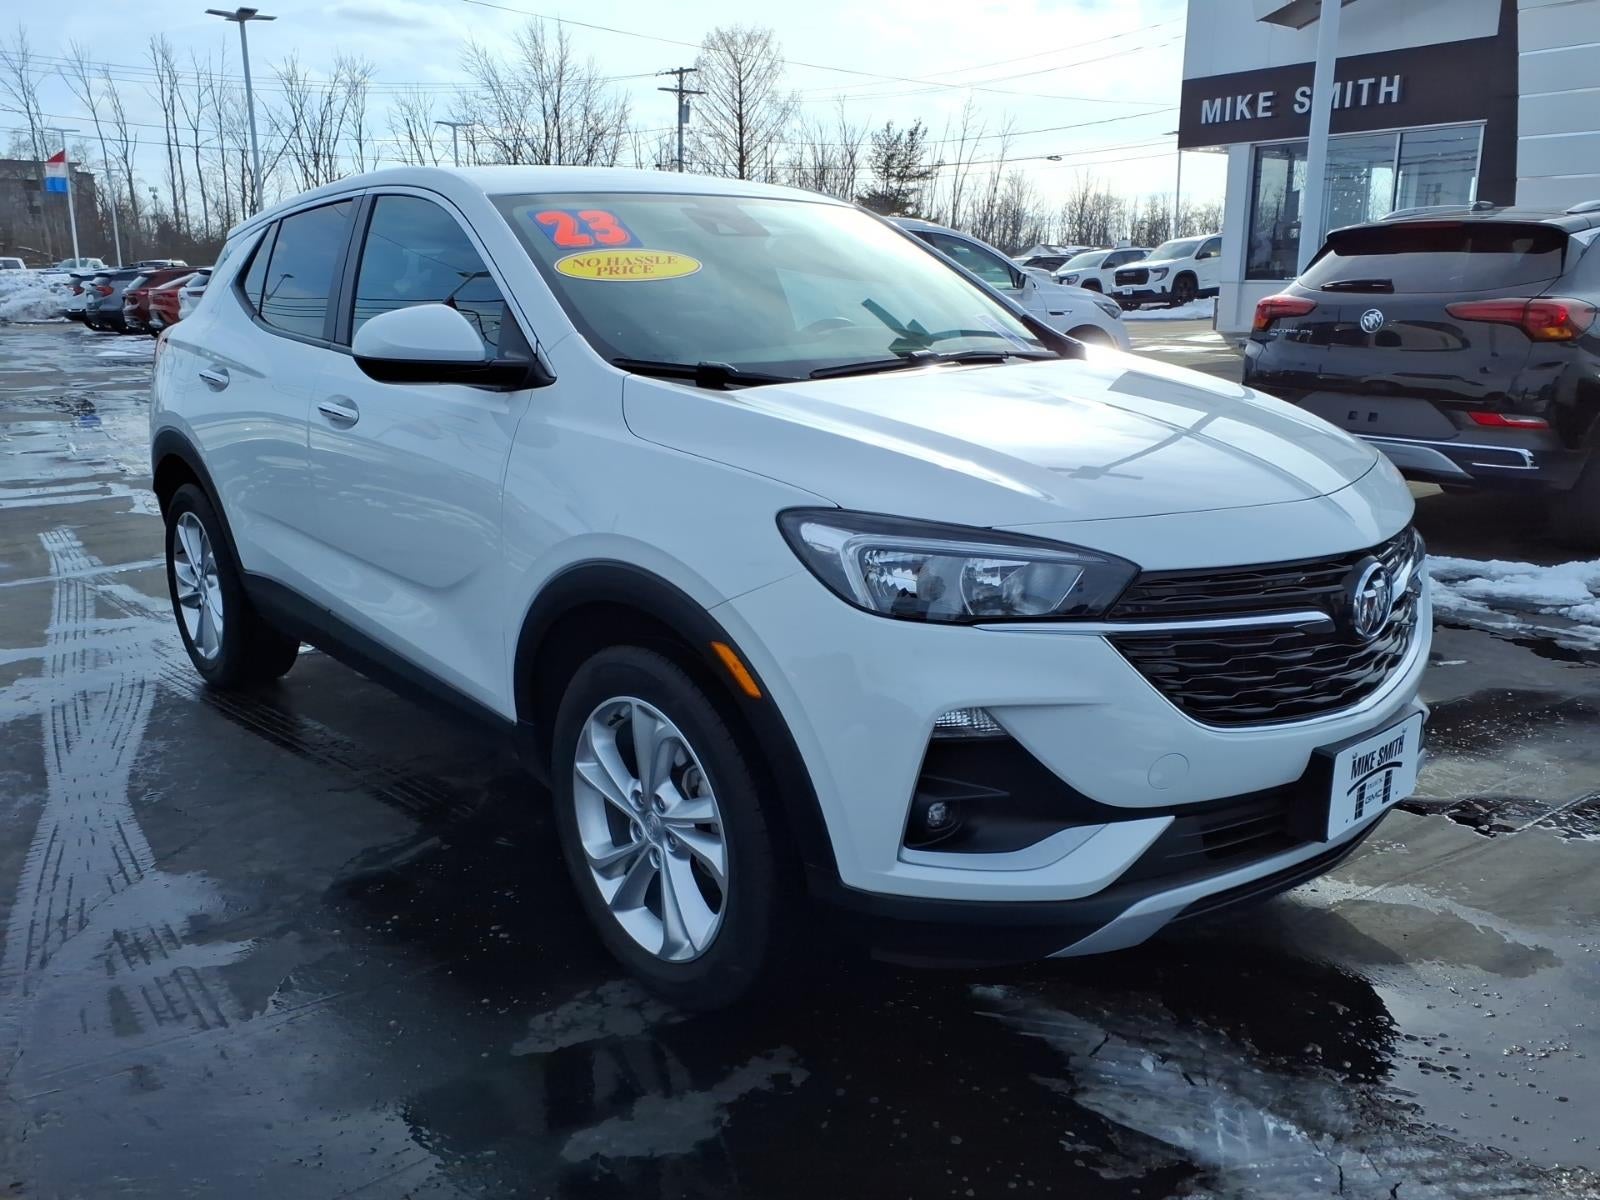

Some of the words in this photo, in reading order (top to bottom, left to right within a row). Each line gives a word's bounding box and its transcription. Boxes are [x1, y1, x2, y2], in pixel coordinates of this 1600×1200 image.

[1201, 91, 1274, 124] MIKE
[535, 210, 630, 247] 23
[572, 258, 601, 269] NO
[604, 256, 677, 266] HASSLE
[596, 265, 653, 276] PRICE
[1351, 751, 1376, 780] MIKE
[1377, 735, 1405, 766] SMITH
